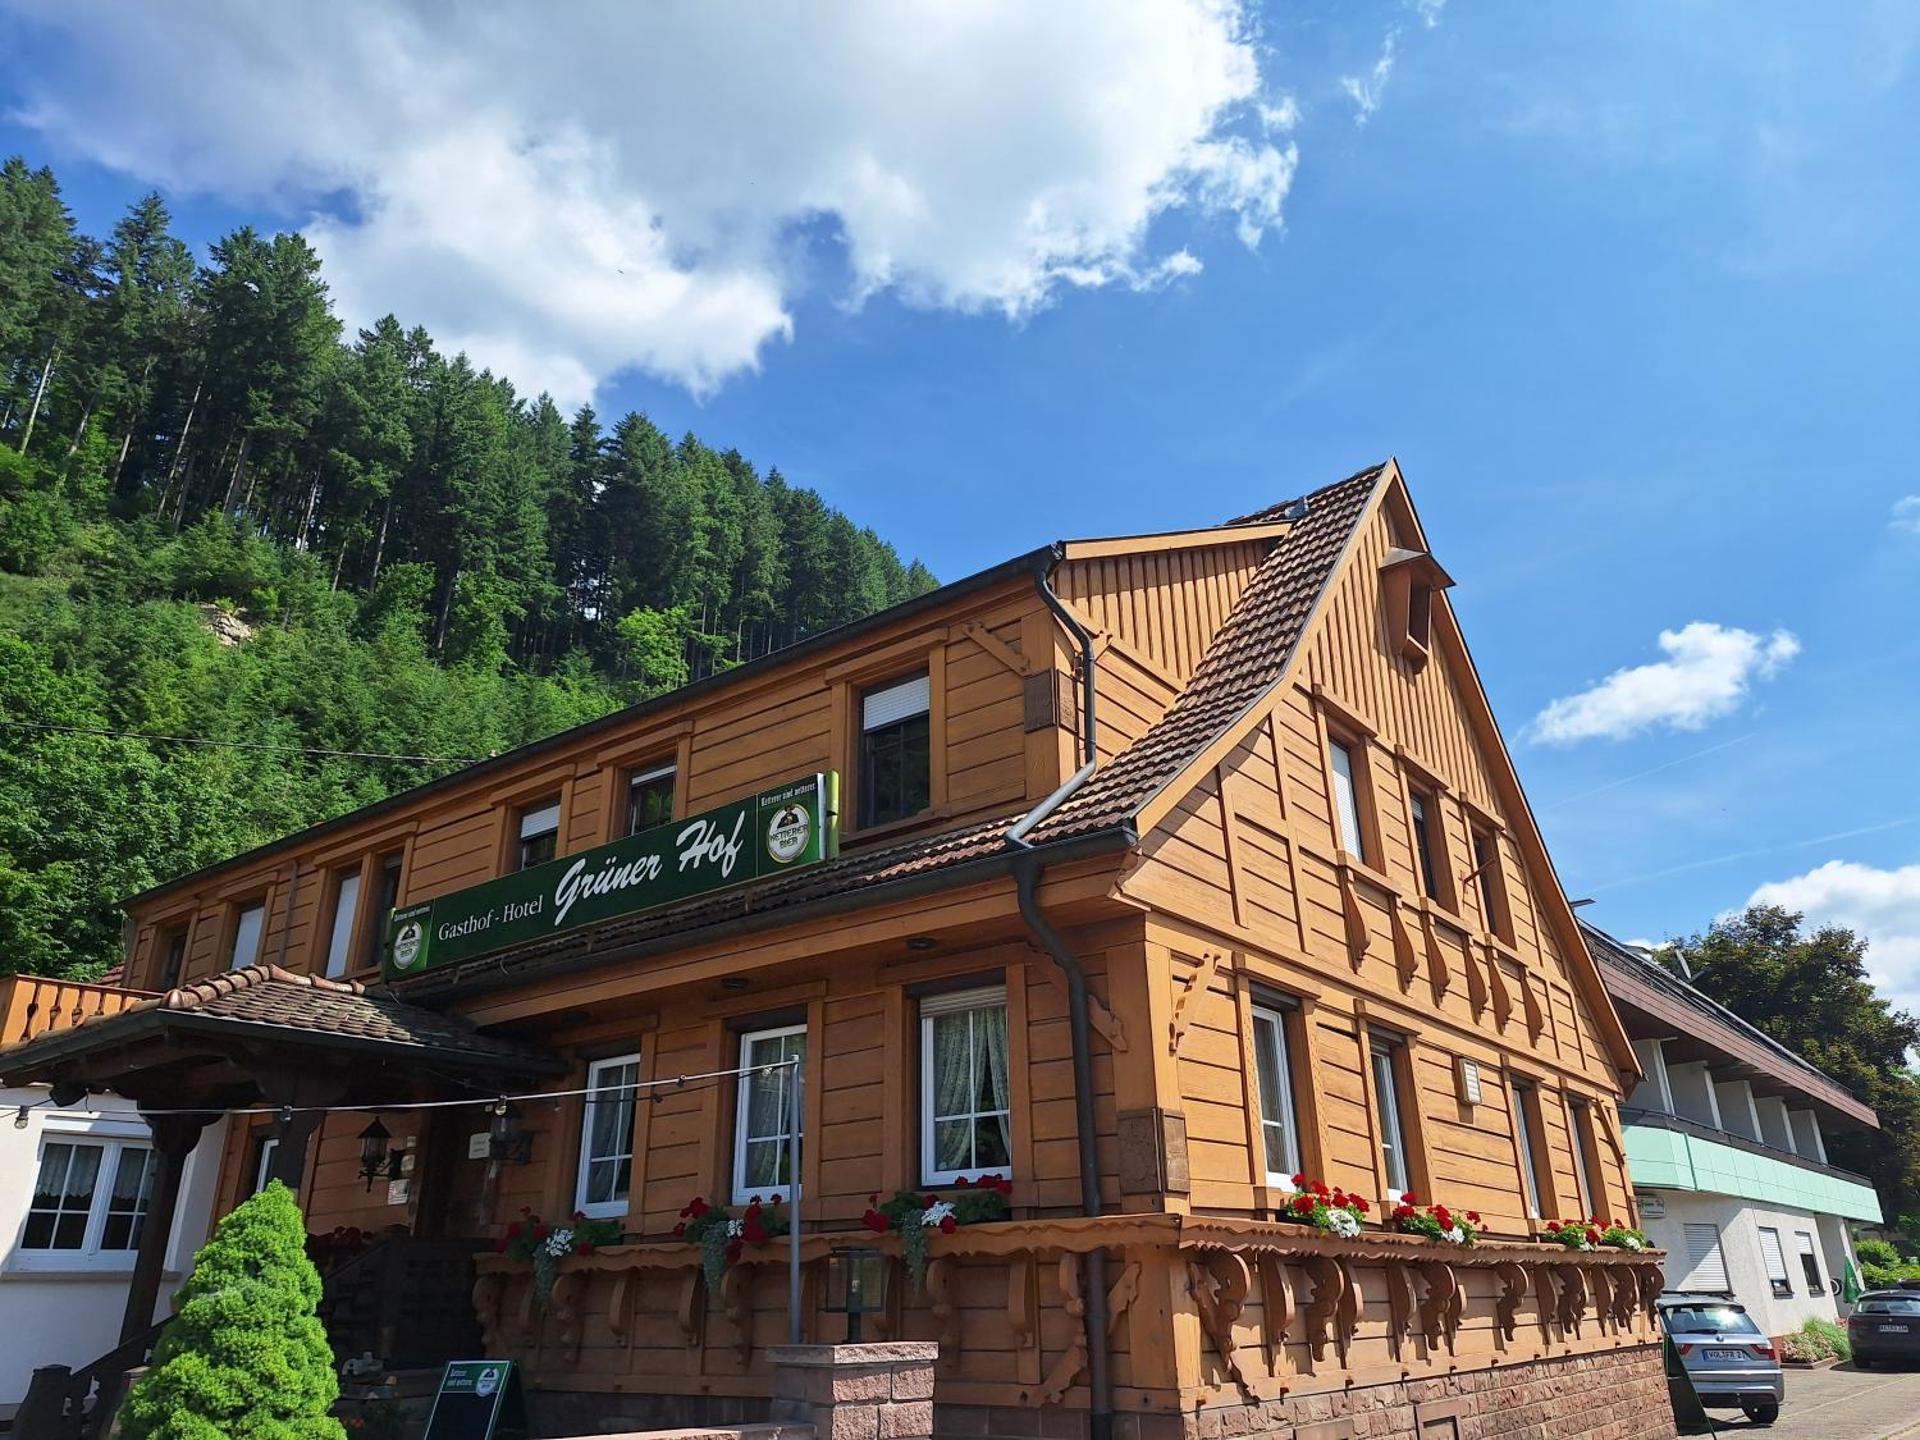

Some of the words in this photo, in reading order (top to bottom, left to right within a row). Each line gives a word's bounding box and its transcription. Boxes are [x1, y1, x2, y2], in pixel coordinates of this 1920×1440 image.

[438, 908, 494, 940] Gasthof
[501, 894, 543, 923] Hotel
[554, 853, 662, 927] Grüner
[675, 810, 745, 878] Hof
